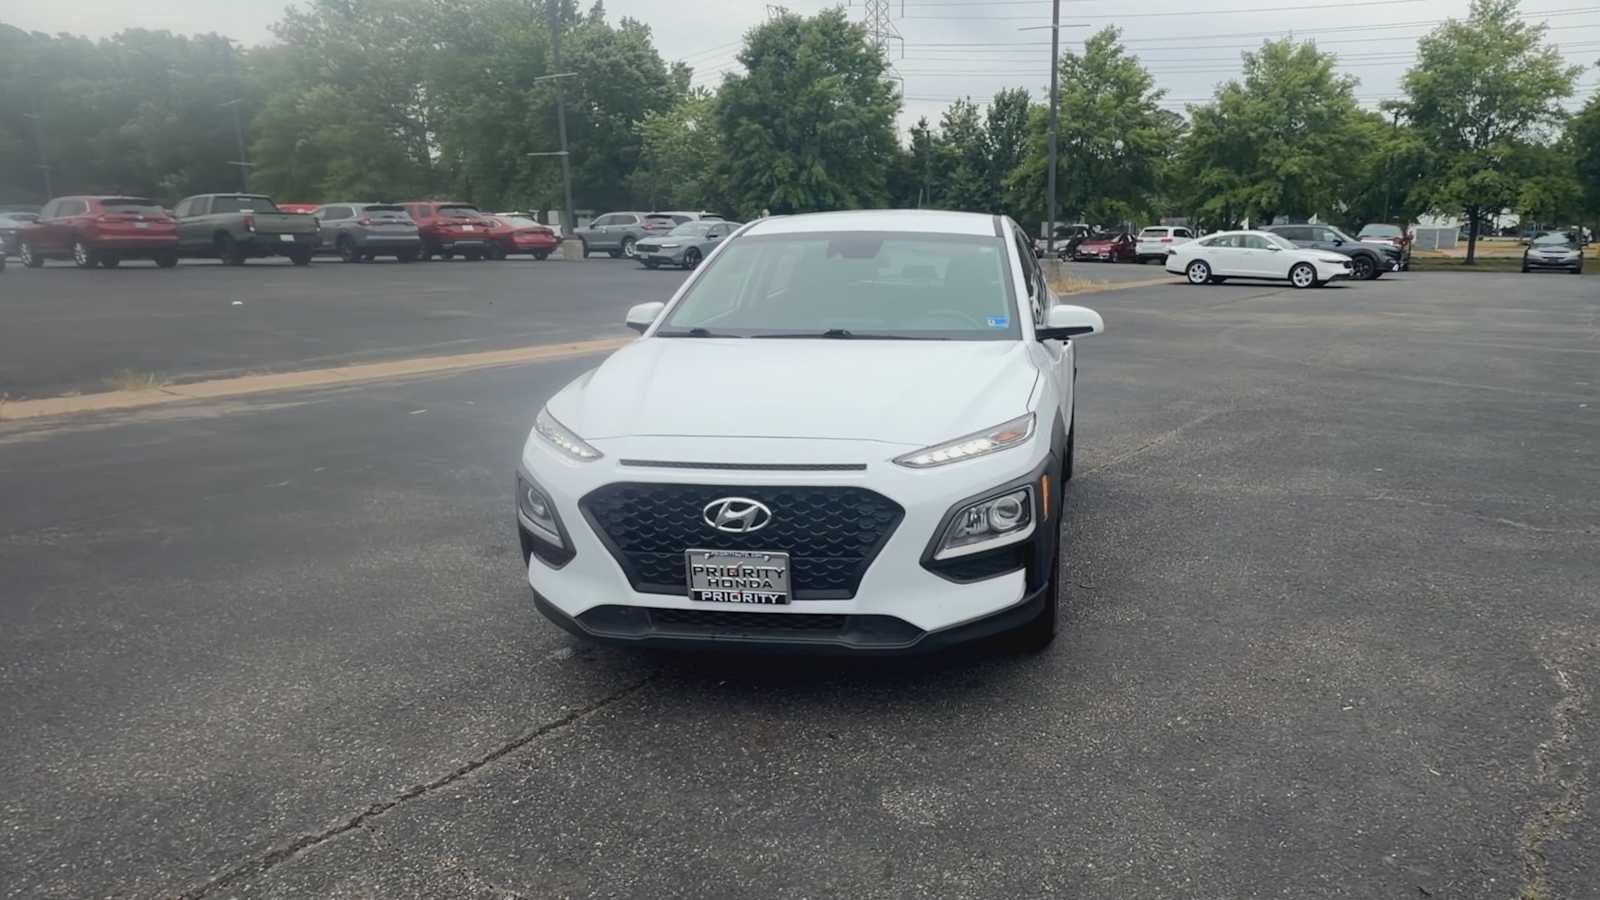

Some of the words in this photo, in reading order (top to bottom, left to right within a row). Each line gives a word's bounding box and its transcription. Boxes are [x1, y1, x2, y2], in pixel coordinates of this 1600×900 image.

[693, 564, 785, 578] PRIORITY
[707, 578, 773, 589] HONDA
[701, 591, 779, 604] PRIORITY
